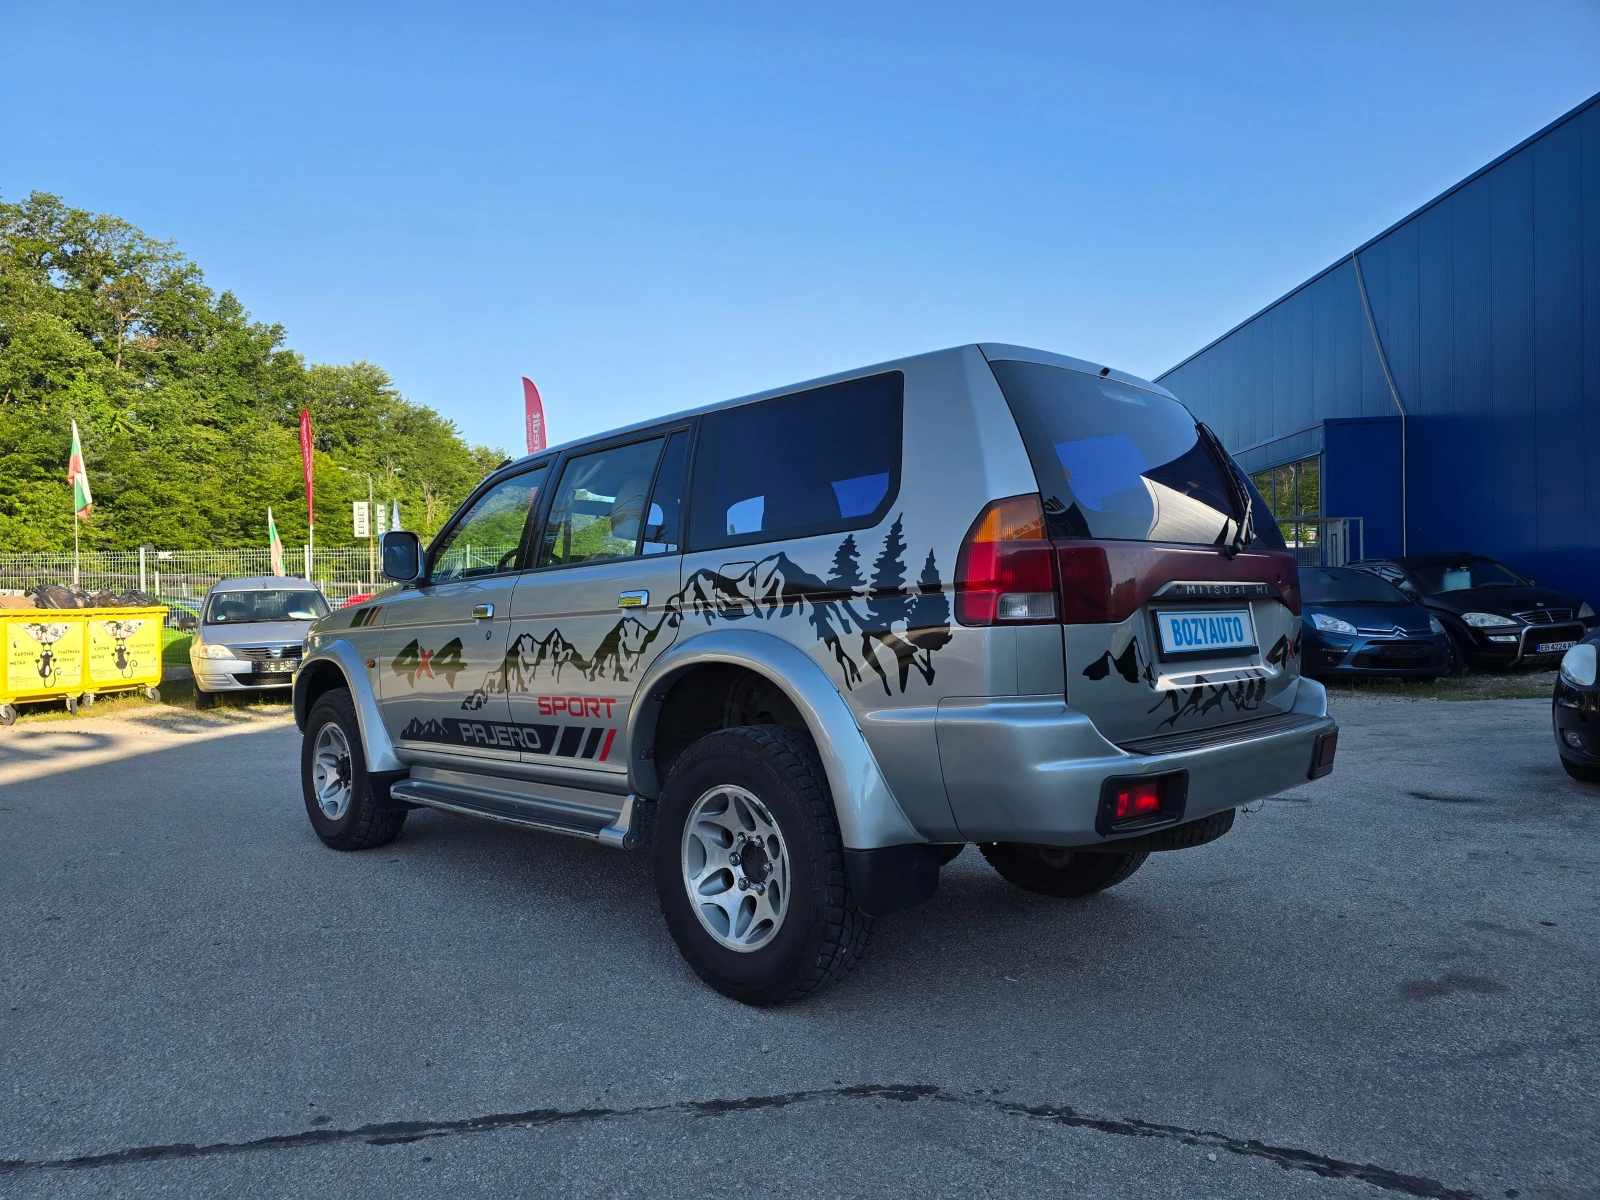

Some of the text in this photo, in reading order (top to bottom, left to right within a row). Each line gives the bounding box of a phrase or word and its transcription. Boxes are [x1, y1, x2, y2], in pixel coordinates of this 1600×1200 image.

[357, 504, 365, 535] EFBET
[377, 503, 386, 535] EFBET
[1170, 616, 1244, 647] BOZYAUTO
[538, 696, 616, 718] SPORT
[458, 723, 541, 749] PAJERO
